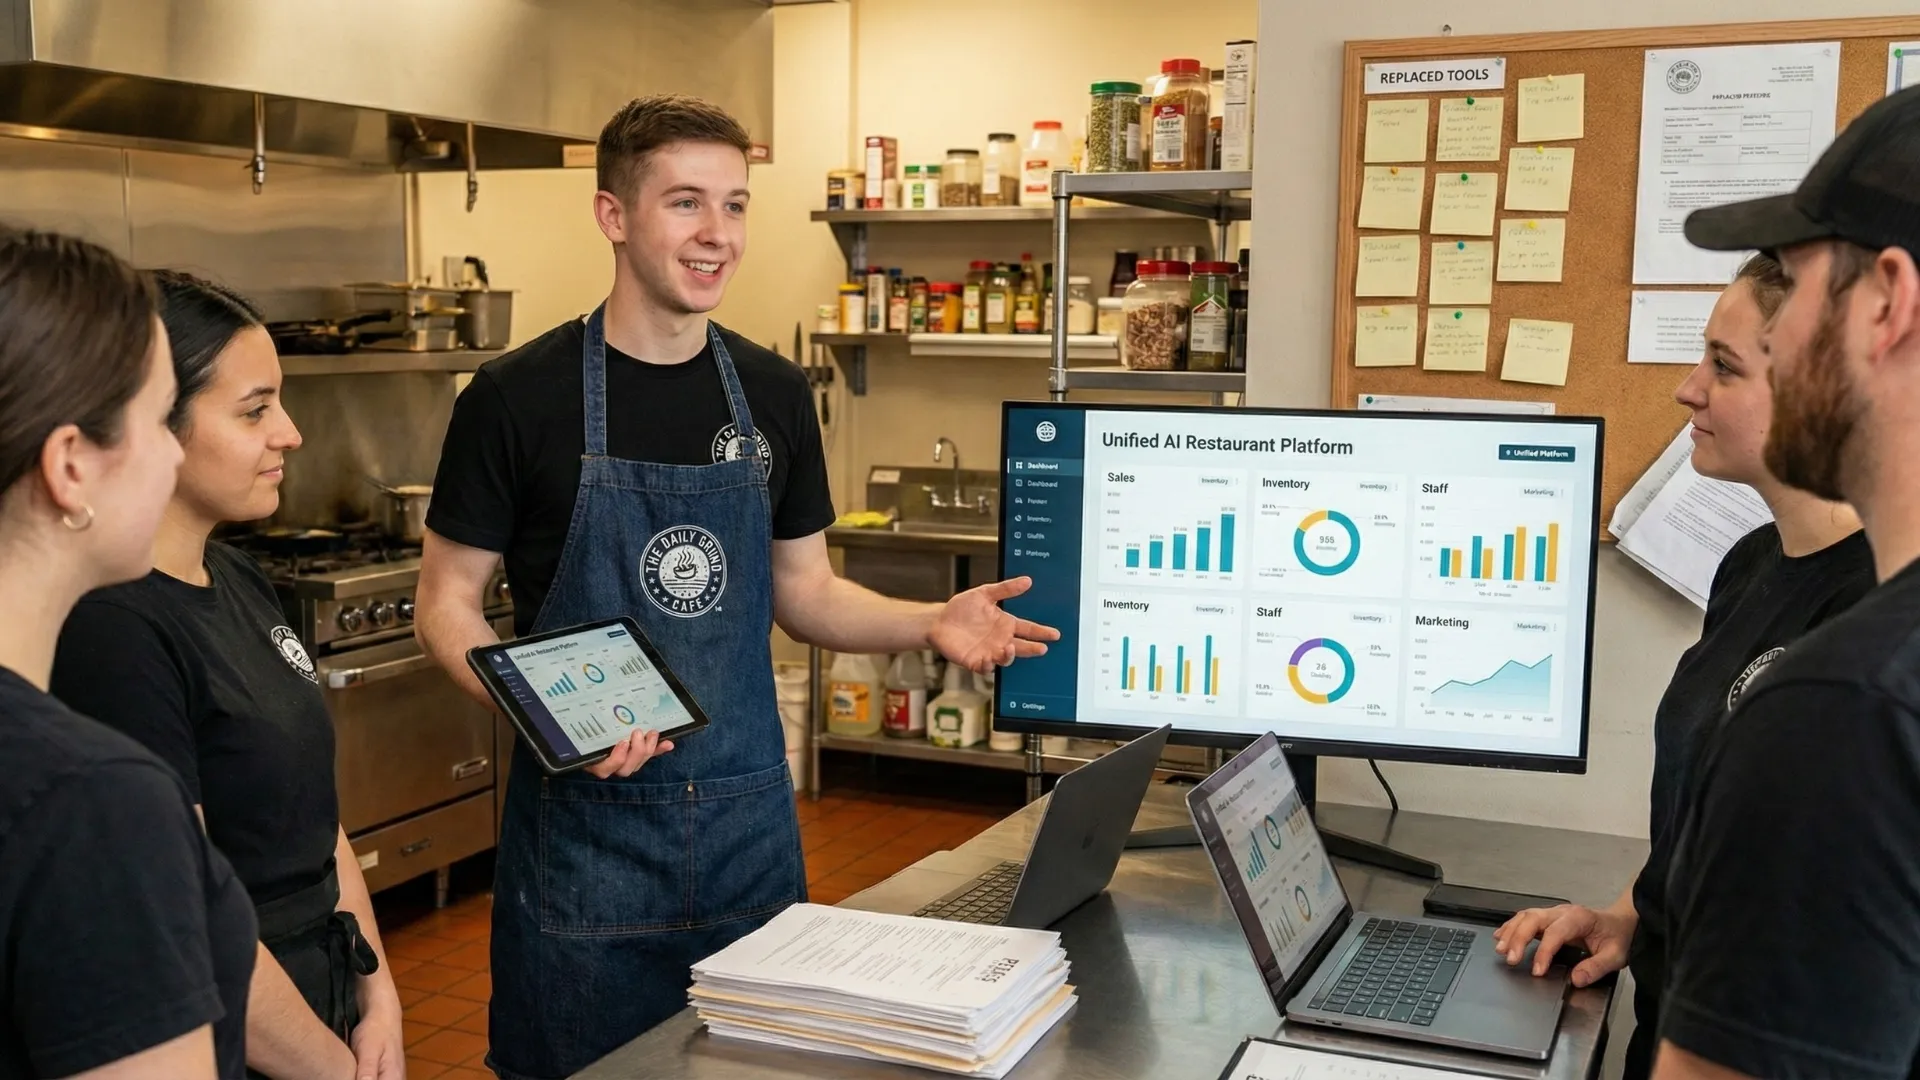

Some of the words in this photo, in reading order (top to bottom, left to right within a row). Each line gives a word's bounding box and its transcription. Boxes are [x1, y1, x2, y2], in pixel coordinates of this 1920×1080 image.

[1380, 70, 1444, 84] REPLACED
[1447, 68, 1489, 81] TOOLS
[716, 438, 727, 458] THE
[1102, 432, 1159, 449] Unified
[1163, 434, 1181, 449] AI
[1186, 434, 1275, 453] Restaurant
[1280, 437, 1353, 455] Platform
[1107, 472, 1136, 483] Sales
[1262, 477, 1310, 491] Inventory
[1421, 482, 1449, 494] Staff
[645, 547, 663, 573] THE
[660, 530, 697, 549] DAILY
[698, 535, 722, 572] GRIND
[672, 597, 704, 612] CAFE
[1103, 599, 1150, 612] Inventory
[1256, 606, 1283, 618] Staff
[1415, 615, 1470, 629] Marketing
